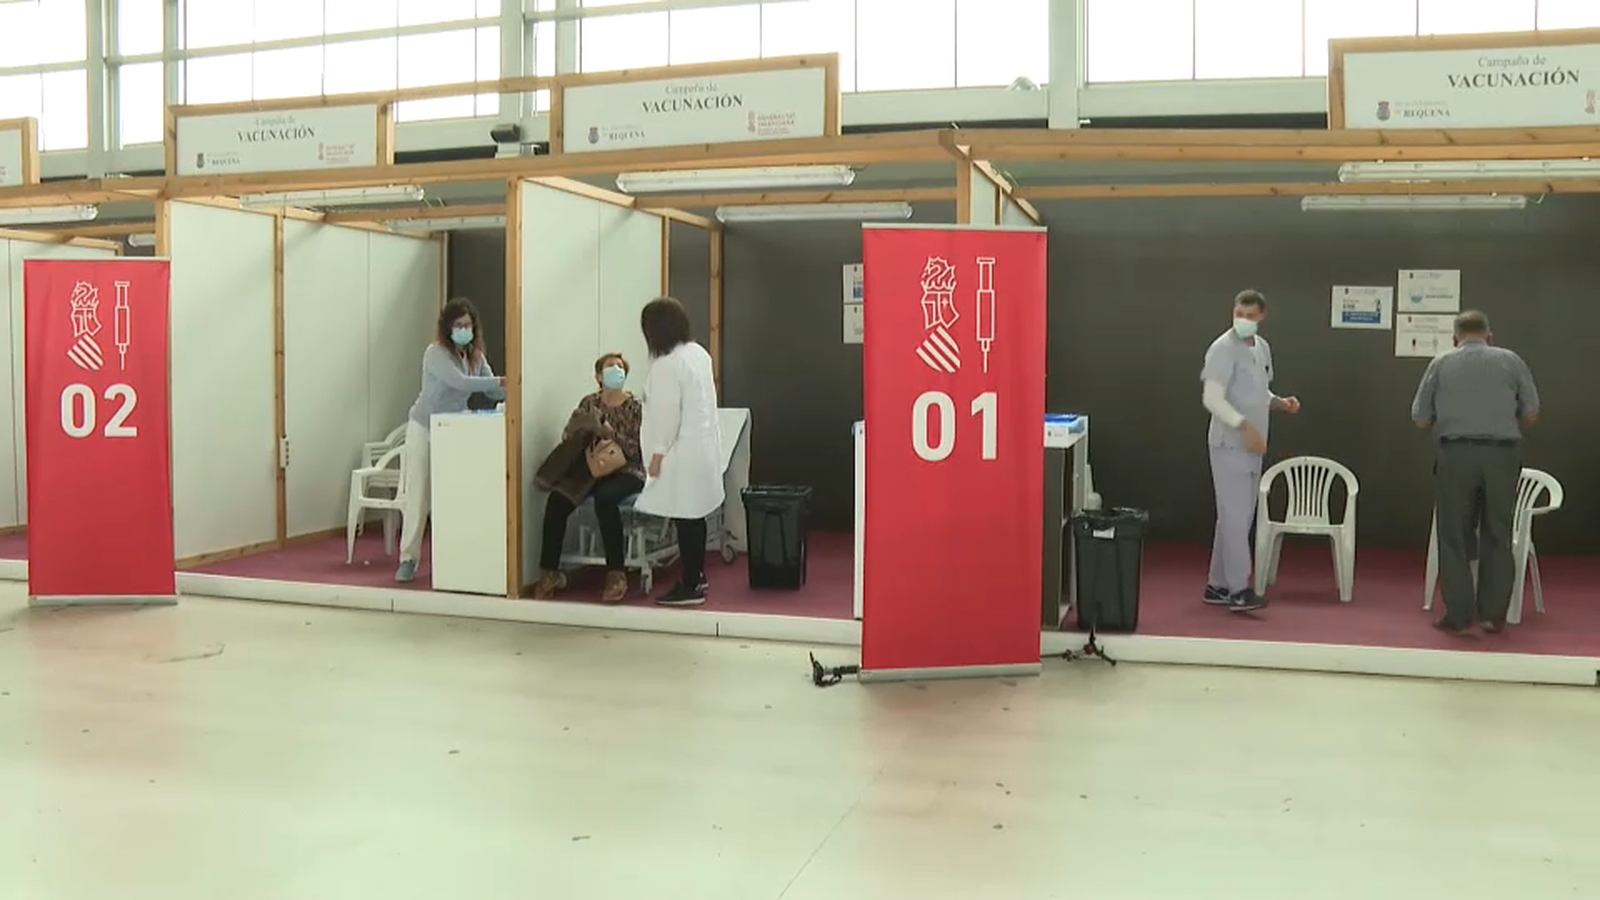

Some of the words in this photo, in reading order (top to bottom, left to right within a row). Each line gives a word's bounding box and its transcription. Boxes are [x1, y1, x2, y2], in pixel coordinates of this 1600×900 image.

[1478, 55, 1529, 69] Campaña
[1533, 53, 1546, 65] de
[1447, 66, 1580, 88] VACUNACIÓN
[642, 93, 743, 113] VACUNACIÓN
[237, 124, 315, 142] VACUNACIÓN
[61, 383, 138, 438] 02
[912, 391, 997, 461] 01
